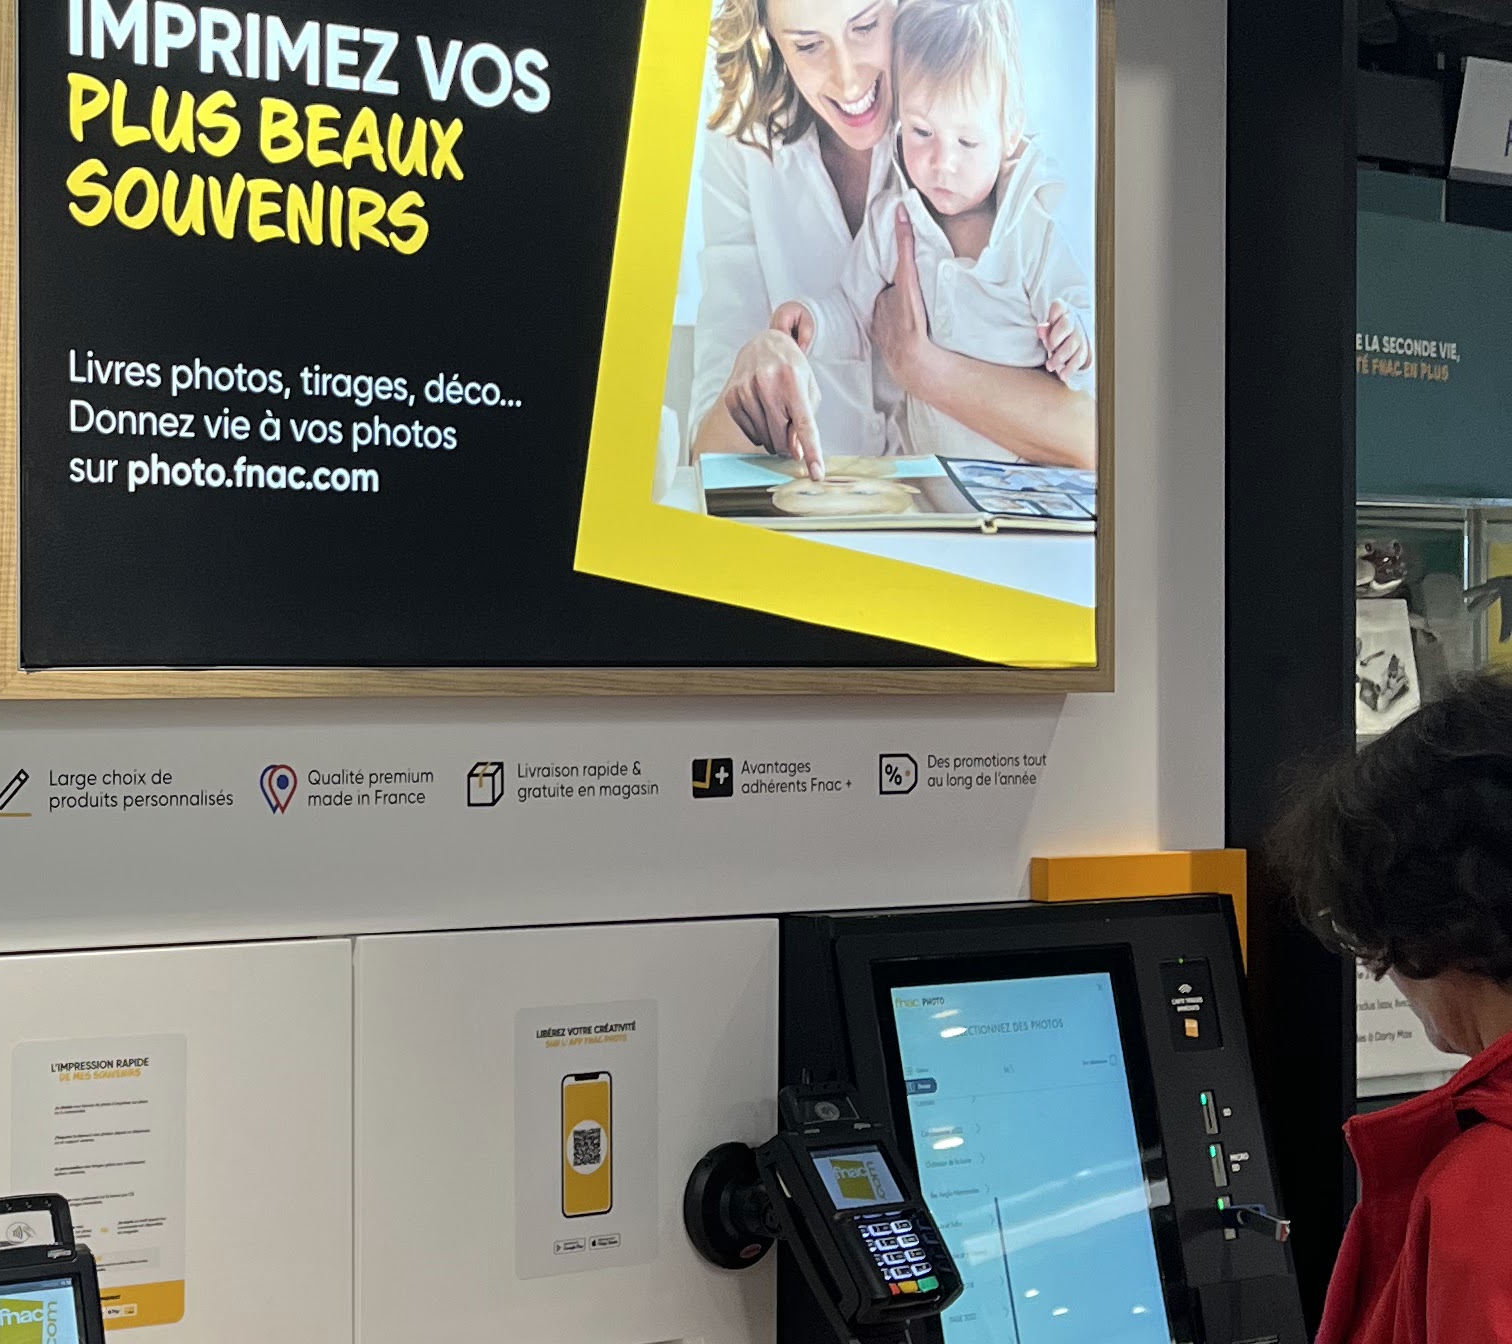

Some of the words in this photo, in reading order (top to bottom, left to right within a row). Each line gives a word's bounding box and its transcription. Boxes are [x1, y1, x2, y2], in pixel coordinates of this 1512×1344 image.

[416, 35, 551, 114] VOS
[67, 73, 241, 156] PLUS
[260, 97, 464, 180] BEAUX
[67, 158, 429, 254] SOUVENIRS
[1365, 334, 1380, 352] LA
[1382, 336, 1437, 358] SECONDE
[1439, 341, 1460, 363] VIE,
[69, 350, 161, 388] Livres
[172, 358, 291, 399] photos,
[300, 365, 415, 406] tirages,
[424, 371, 522, 408] déco...
[69, 400, 195, 437] Donnez
[204, 410, 250, 440] vie
[260, 409, 281, 442] à
[290, 418, 343, 444] vos
[353, 415, 457, 452] photos
[69, 458, 118, 484] sur
[128, 454, 379, 493] photo.fnac.com
[517, 762, 579, 779] Livraison
[583, 761, 628, 780] rapide
[633, 761, 642, 776] &
[741, 760, 811, 779] Avantages
[928, 754, 950, 769] Des
[954, 753, 1019, 771] promotions
[1023, 753, 1047, 768] tout
[49, 770, 97, 790] Large
[102, 769, 146, 787] choix
[151, 768, 173, 785] de
[307, 768, 364, 787] Qualité
[369, 768, 434, 789] premium
[741, 777, 806, 794] adhérents
[811, 777, 842, 792] Fnac
[928, 775, 942, 787] au
[946, 772, 971, 790] long
[975, 772, 991, 786] de
[996, 770, 1037, 786] l'année
[49, 791, 118, 812] produits
[123, 789, 234, 811] personnalisés
[307, 791, 354, 807] made
[358, 790, 370, 806] in
[375, 789, 426, 805] France
[517, 782, 574, 803] gratuite
[578, 784, 595, 796] en
[599, 781, 659, 801] magasin
[567, 1025, 592, 1036] VOTRE
[51, 1060, 113, 1073] L'IMPRESSION
[116, 1057, 149, 1069] RAPIDE
[0, 1307, 44, 1327] fnac
